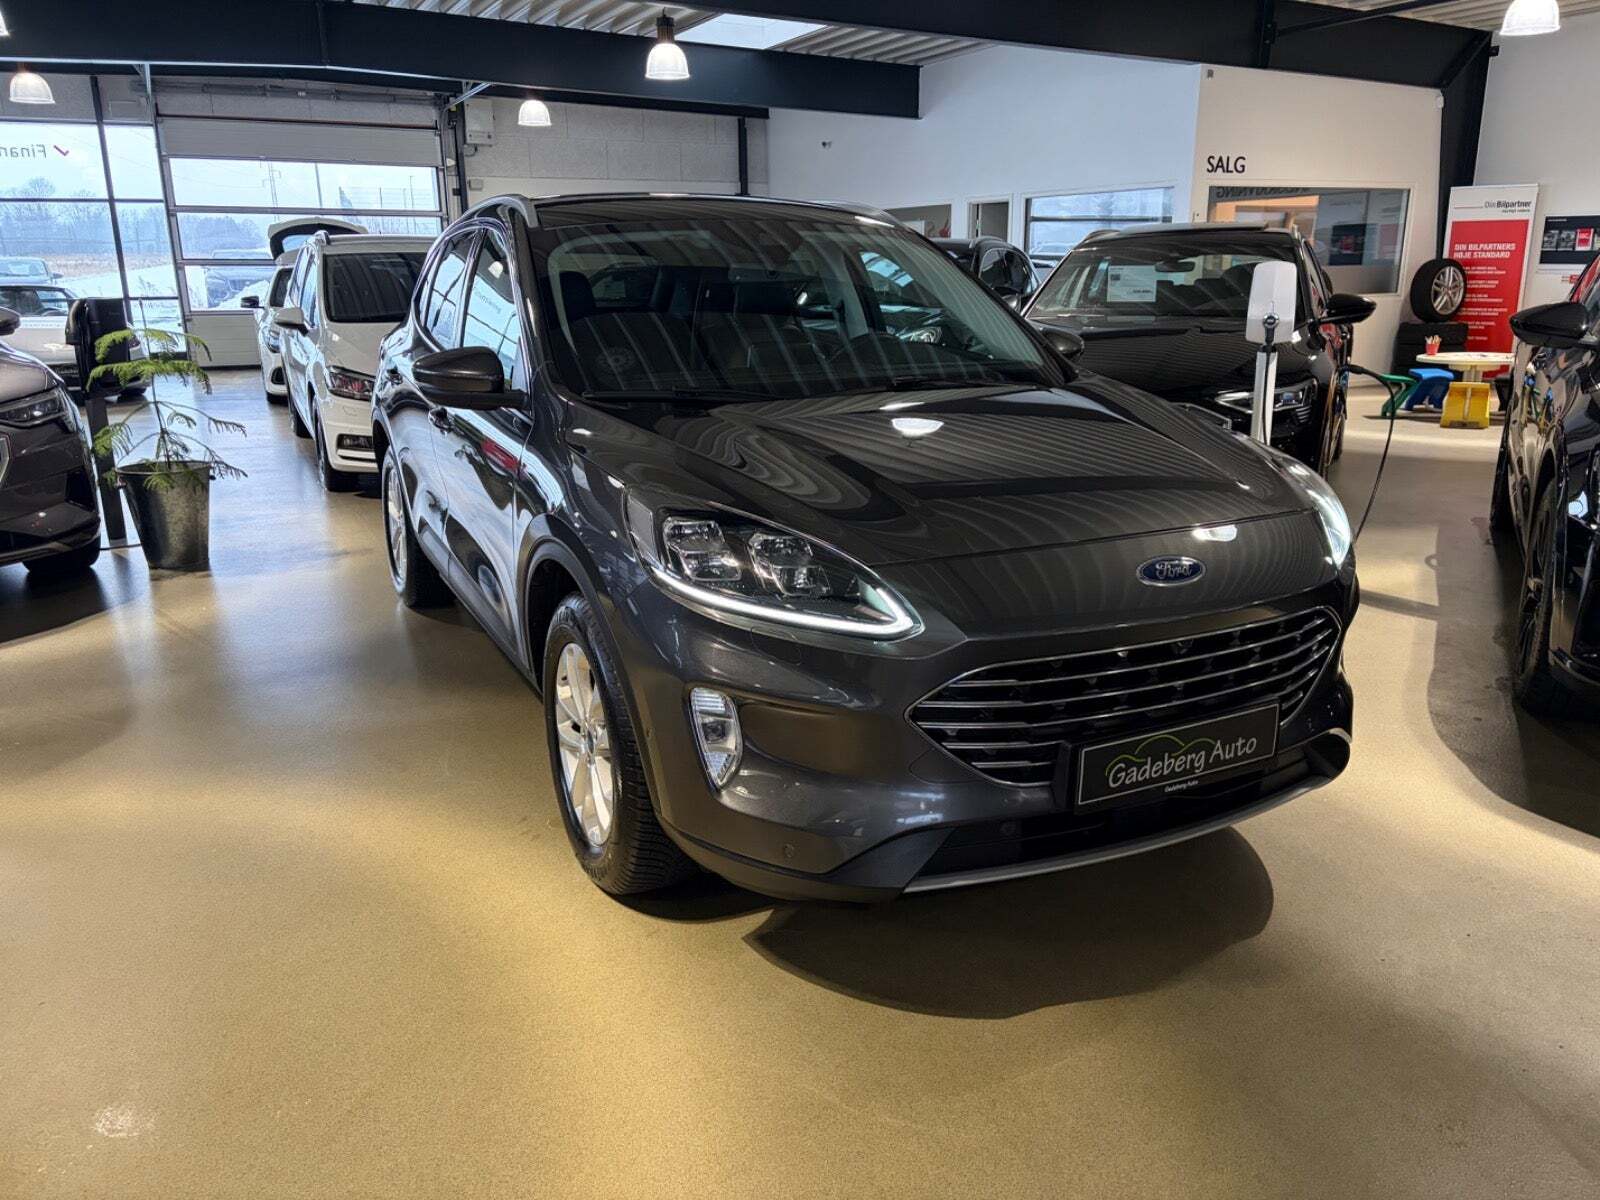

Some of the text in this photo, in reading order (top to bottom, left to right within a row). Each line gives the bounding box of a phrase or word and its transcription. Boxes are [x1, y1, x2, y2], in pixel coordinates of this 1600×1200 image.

[1206, 155, 1246, 174] SALG
[1496, 200, 1532, 209] Bilpartner
[1454, 242, 1516, 251] DIN BILPARTNERS
[1473, 251, 1510, 259] STANDARD
[1155, 561, 1193, 580] Ford
[1108, 737, 1257, 788] Gadeberg Auto
